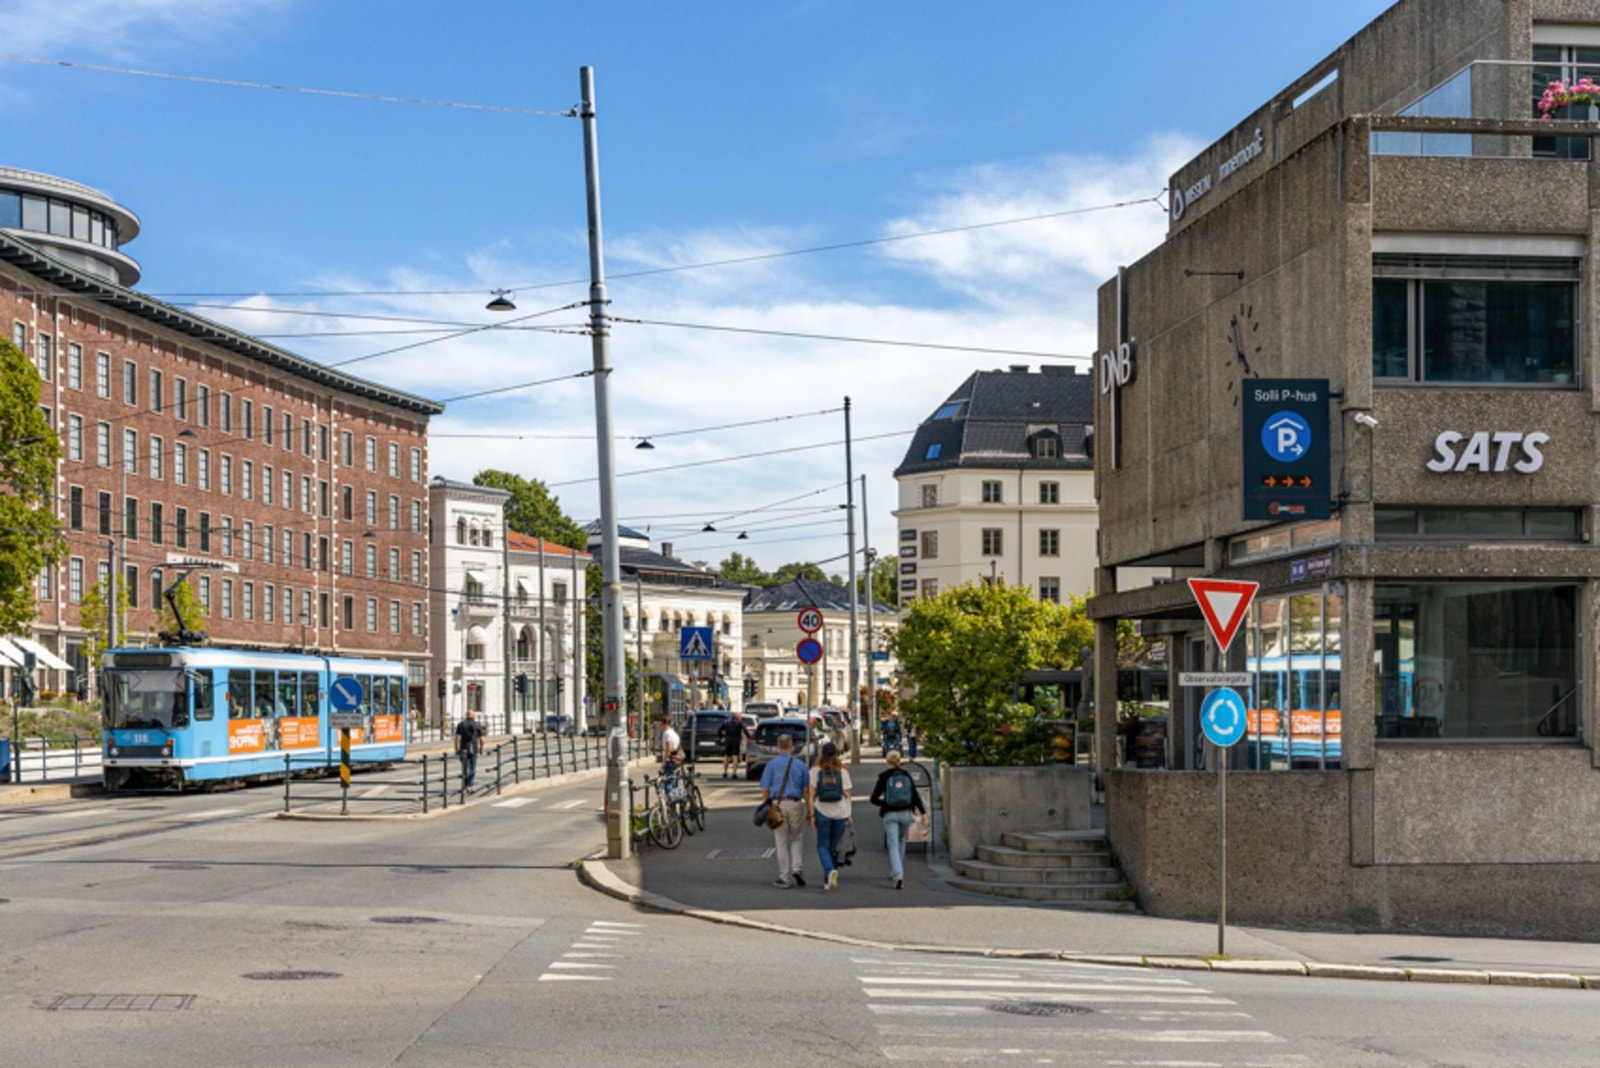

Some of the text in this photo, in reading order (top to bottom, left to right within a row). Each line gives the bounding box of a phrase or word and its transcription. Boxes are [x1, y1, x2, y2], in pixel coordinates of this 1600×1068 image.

[1102, 342, 1131, 394] DNB
[1254, 389, 1317, 402] Solli P-hus
[1277, 427, 1298, 453] P
[1426, 430, 1550, 474] SATS
[802, 613, 820, 628] 40
